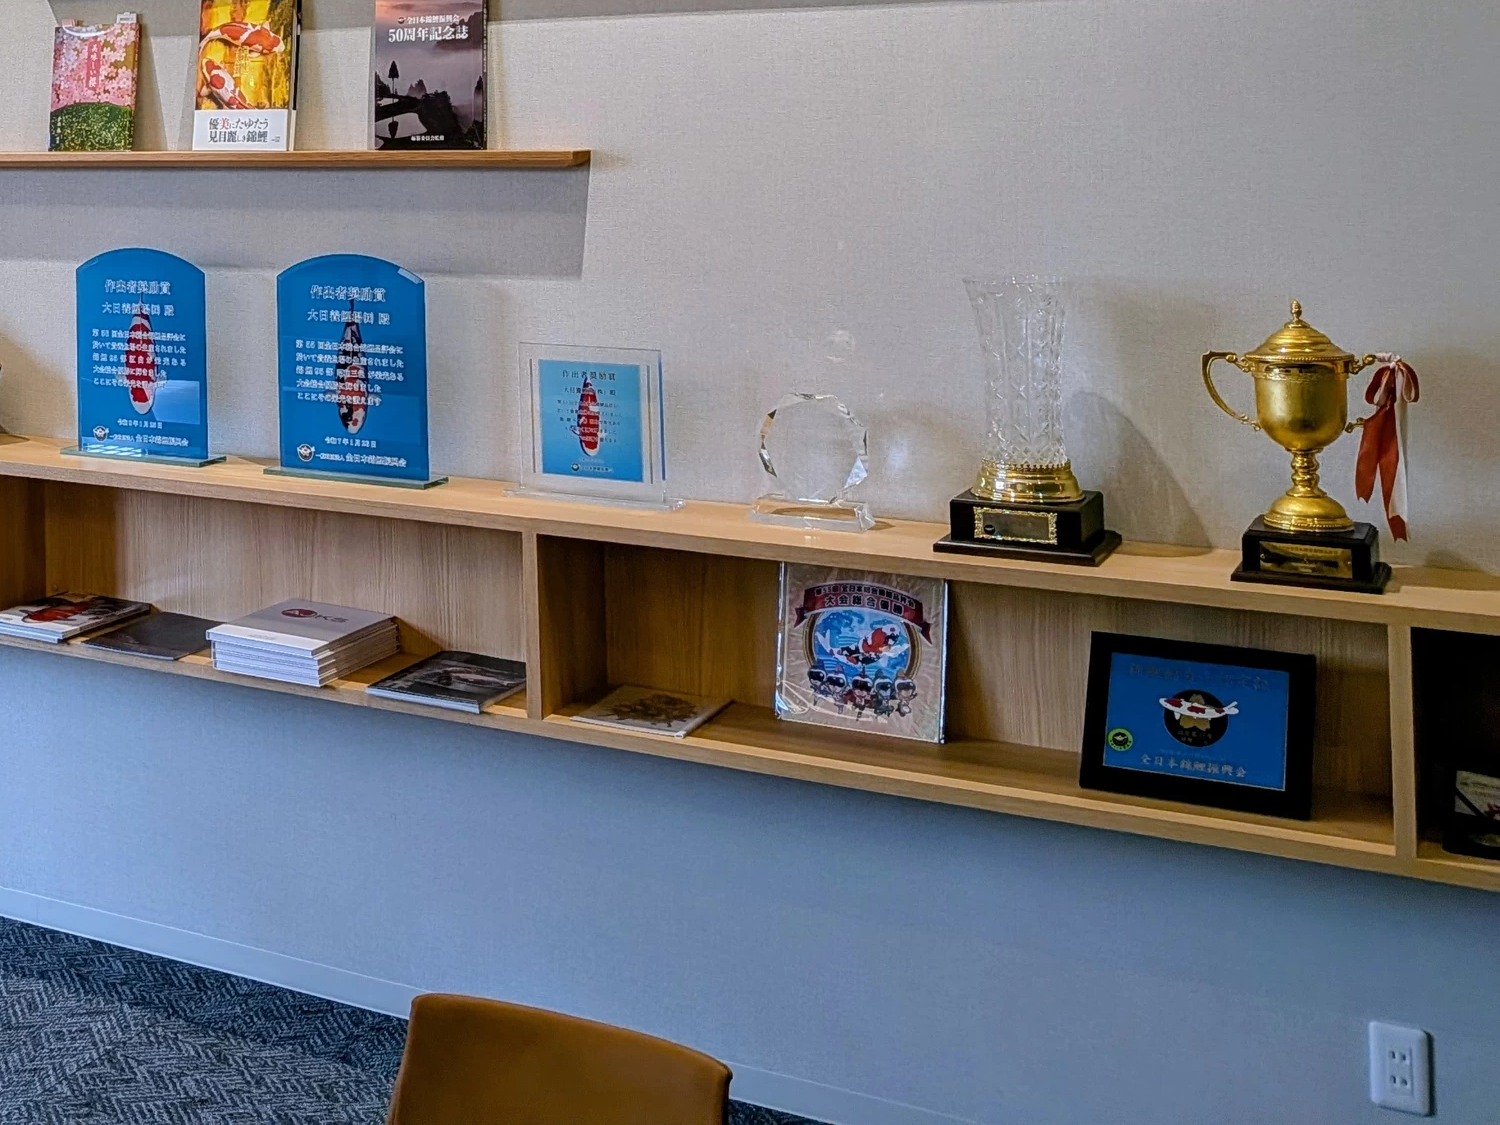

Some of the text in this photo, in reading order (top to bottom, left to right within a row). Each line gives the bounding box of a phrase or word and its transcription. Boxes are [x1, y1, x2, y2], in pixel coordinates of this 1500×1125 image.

[388, 25, 469, 43] 50周年記念誌
[209, 117, 269, 130] 優美にたゆたう
[208, 131, 268, 143] 見目麗しき錦鯉
[105, 279, 171, 295] 作出者奨励賞
[310, 285, 386, 302] 作出者奨励賞
[1141, 753, 1247, 778] 全日本錦鯉振興会
